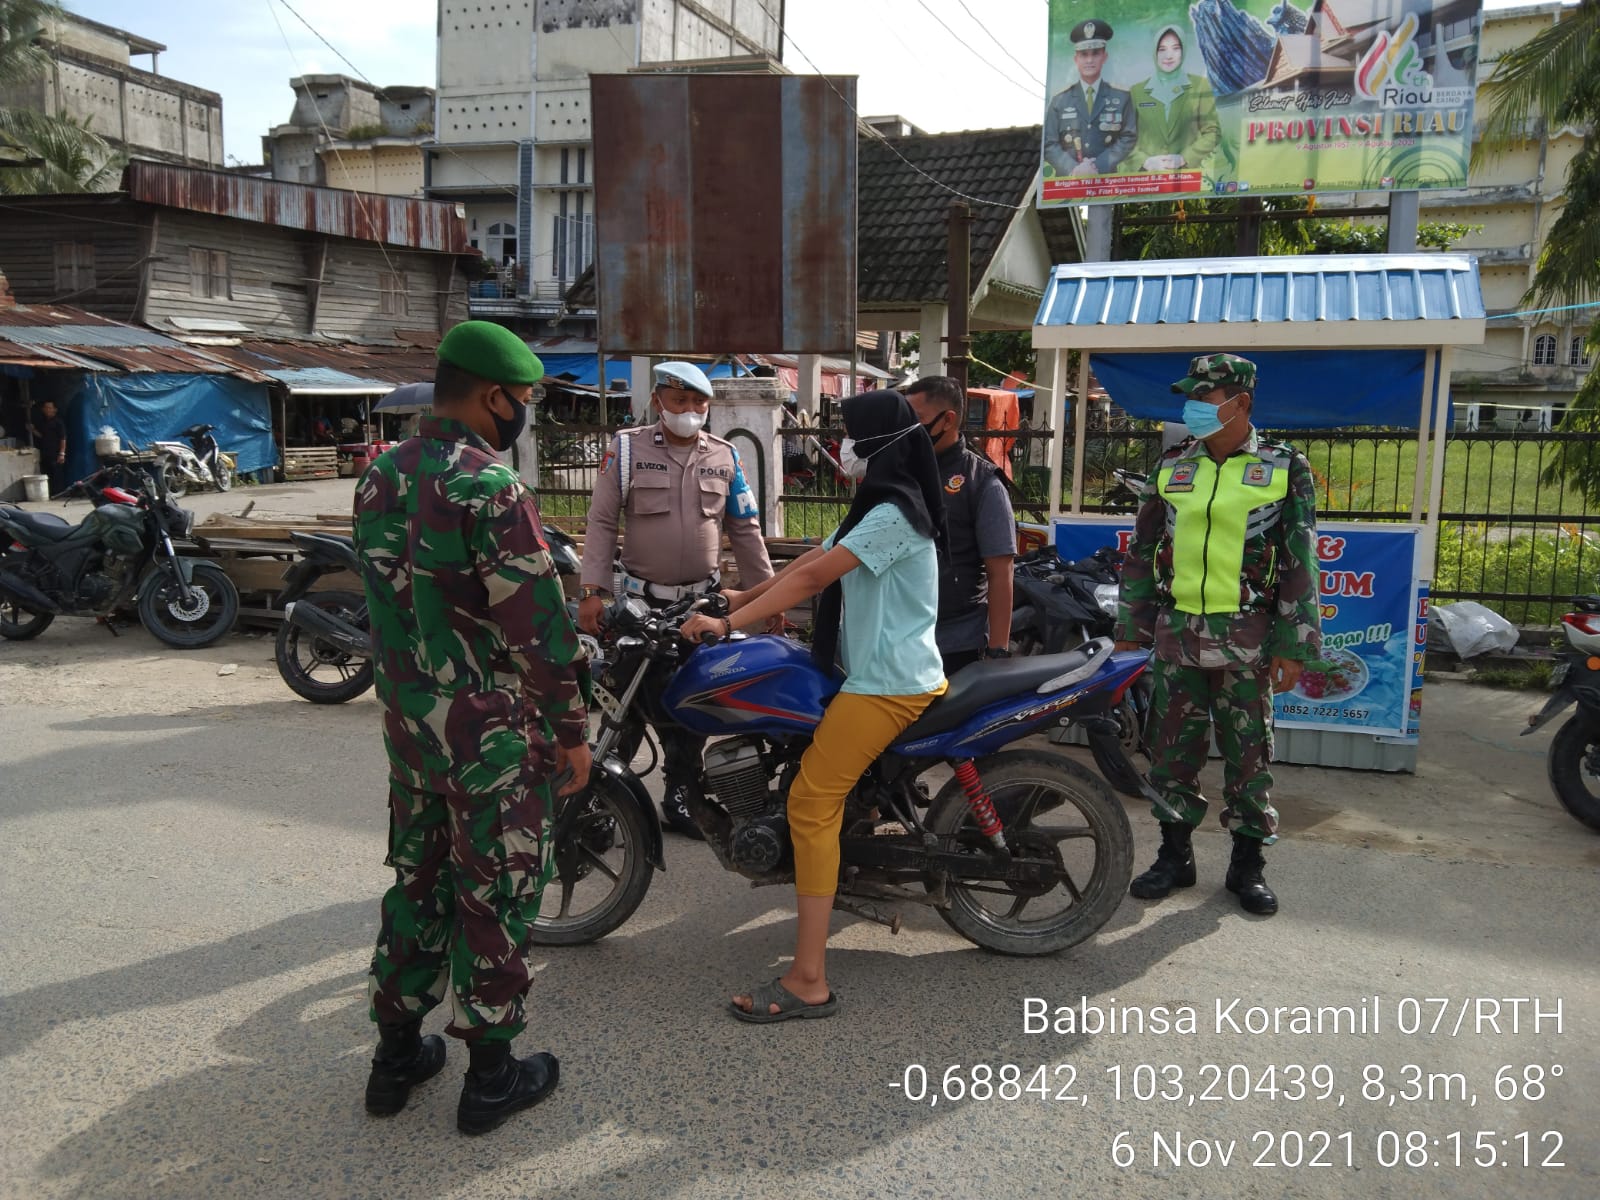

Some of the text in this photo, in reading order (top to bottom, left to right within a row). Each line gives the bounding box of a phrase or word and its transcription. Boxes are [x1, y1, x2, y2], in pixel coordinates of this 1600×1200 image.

[1249, 90, 1351, 112] Selamat Hari Jadi
[1383, 88, 1433, 105] Riau
[1248, 109, 1468, 143] PROVINSI RIAU
[700, 467, 729, 478] POLRI
[1317, 536, 1345, 560] &
[1320, 631, 1363, 651] egar
[710, 666, 747, 680] HONDA
[1283, 704, 1309, 716] 0852
[1312, 706, 1339, 718] 7222
[1343, 708, 1369, 719] 5657
